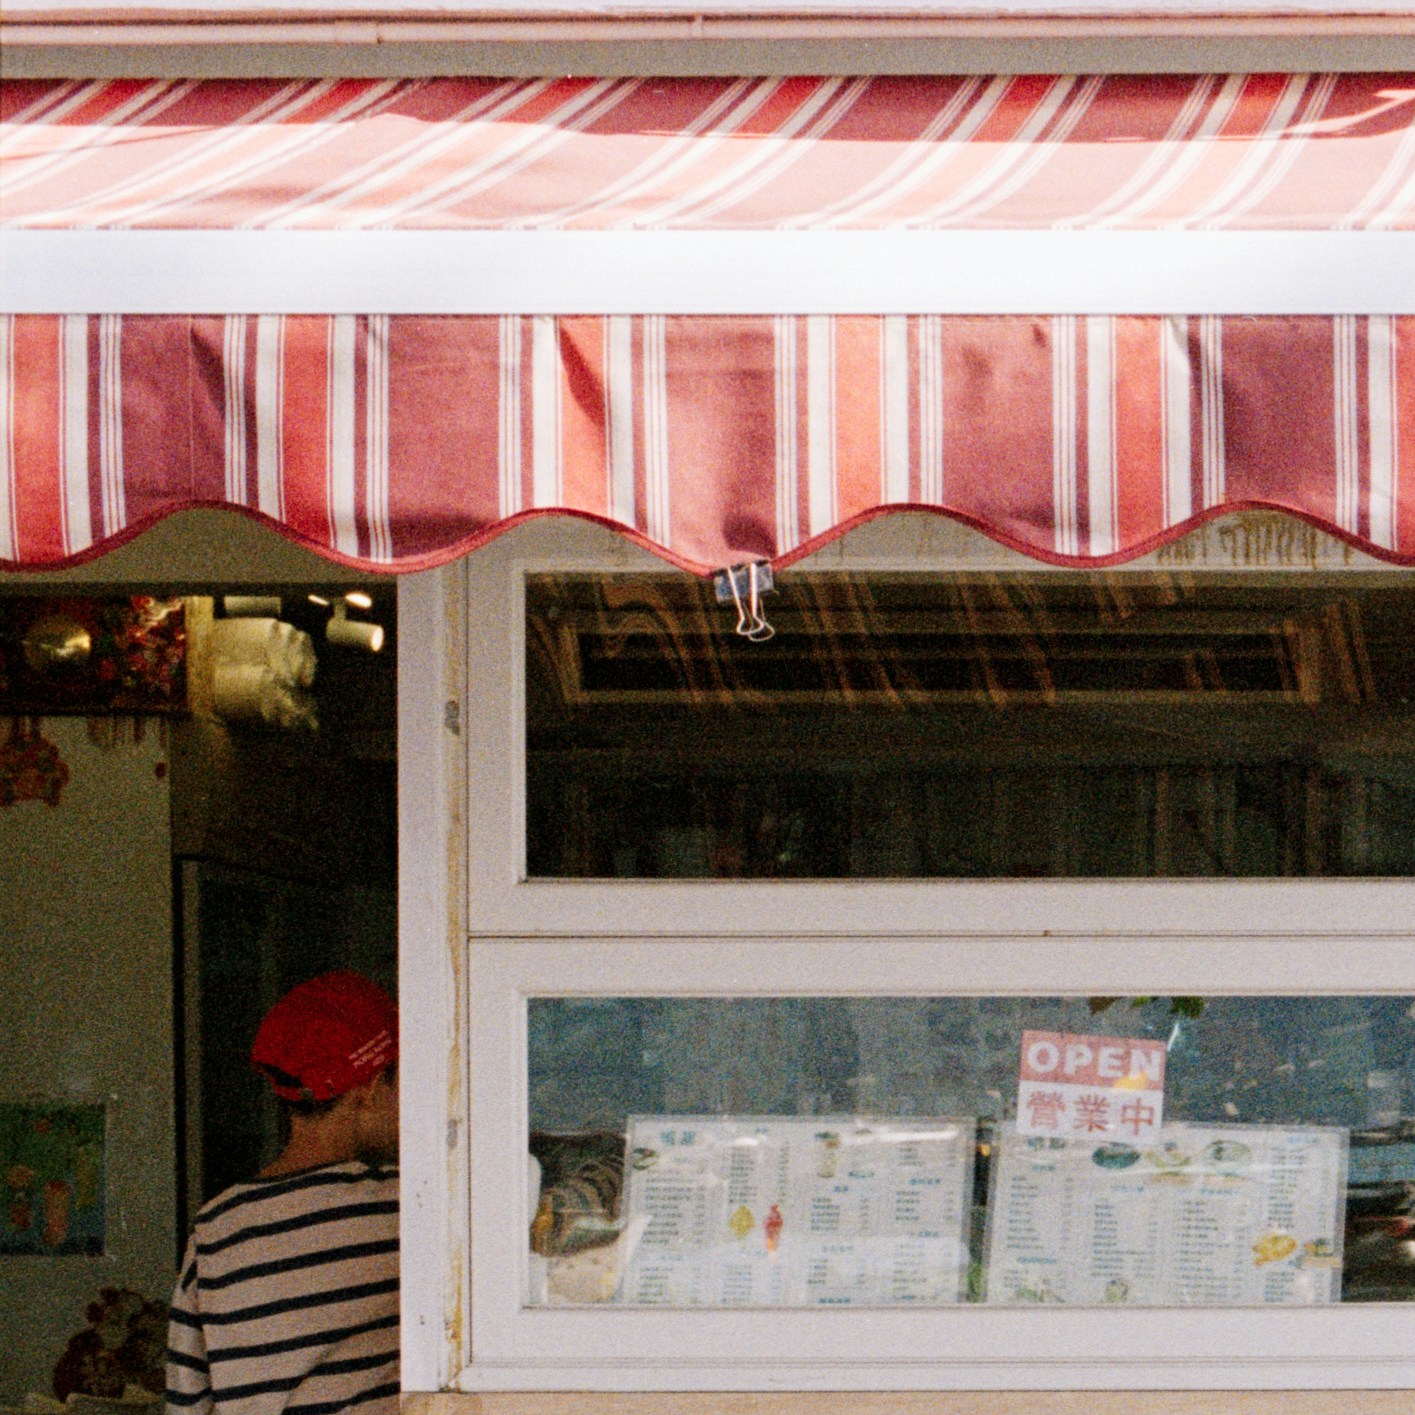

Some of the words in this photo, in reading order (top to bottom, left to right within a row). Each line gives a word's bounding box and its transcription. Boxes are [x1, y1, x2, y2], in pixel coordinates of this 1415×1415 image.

[1026, 1040, 1162, 1082] OPEN
[1026, 1090, 1155, 1136] 營業中
